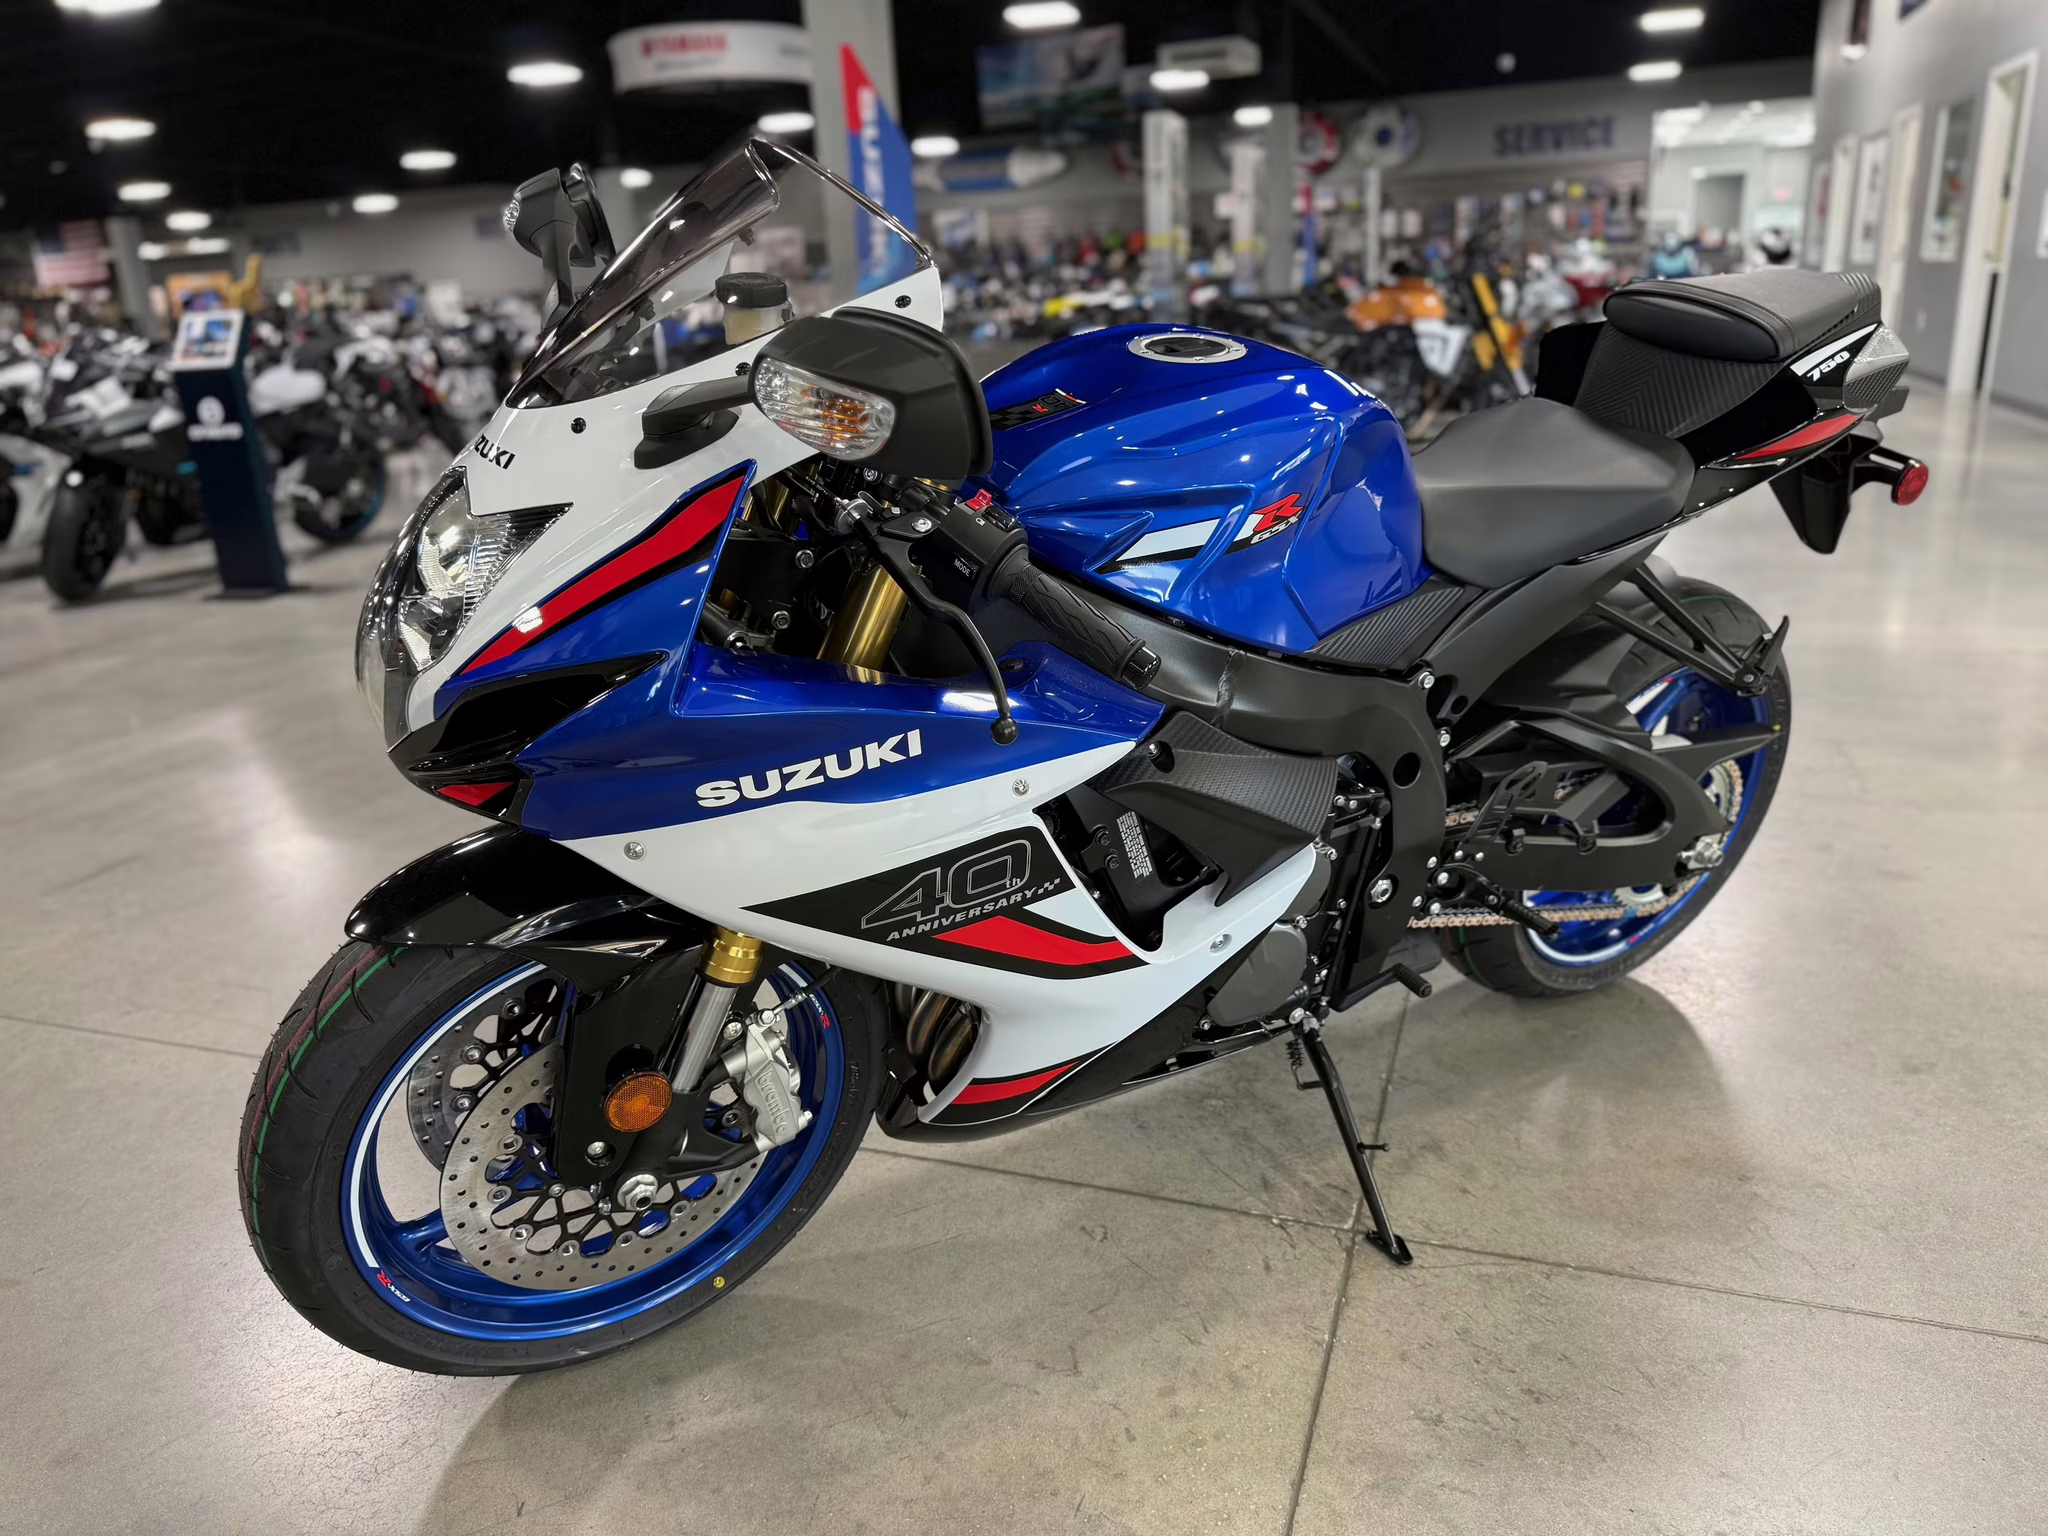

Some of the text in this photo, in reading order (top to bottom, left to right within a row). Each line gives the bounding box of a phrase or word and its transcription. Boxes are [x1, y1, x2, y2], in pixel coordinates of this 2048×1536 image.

[1807, 351, 1850, 381] 750
[953, 558, 971, 577] MODE
[695, 729, 922, 808] SUZUKI
[886, 887, 1038, 941] ANNIVERSARY
[757, 1068, 790, 1134] brembo
